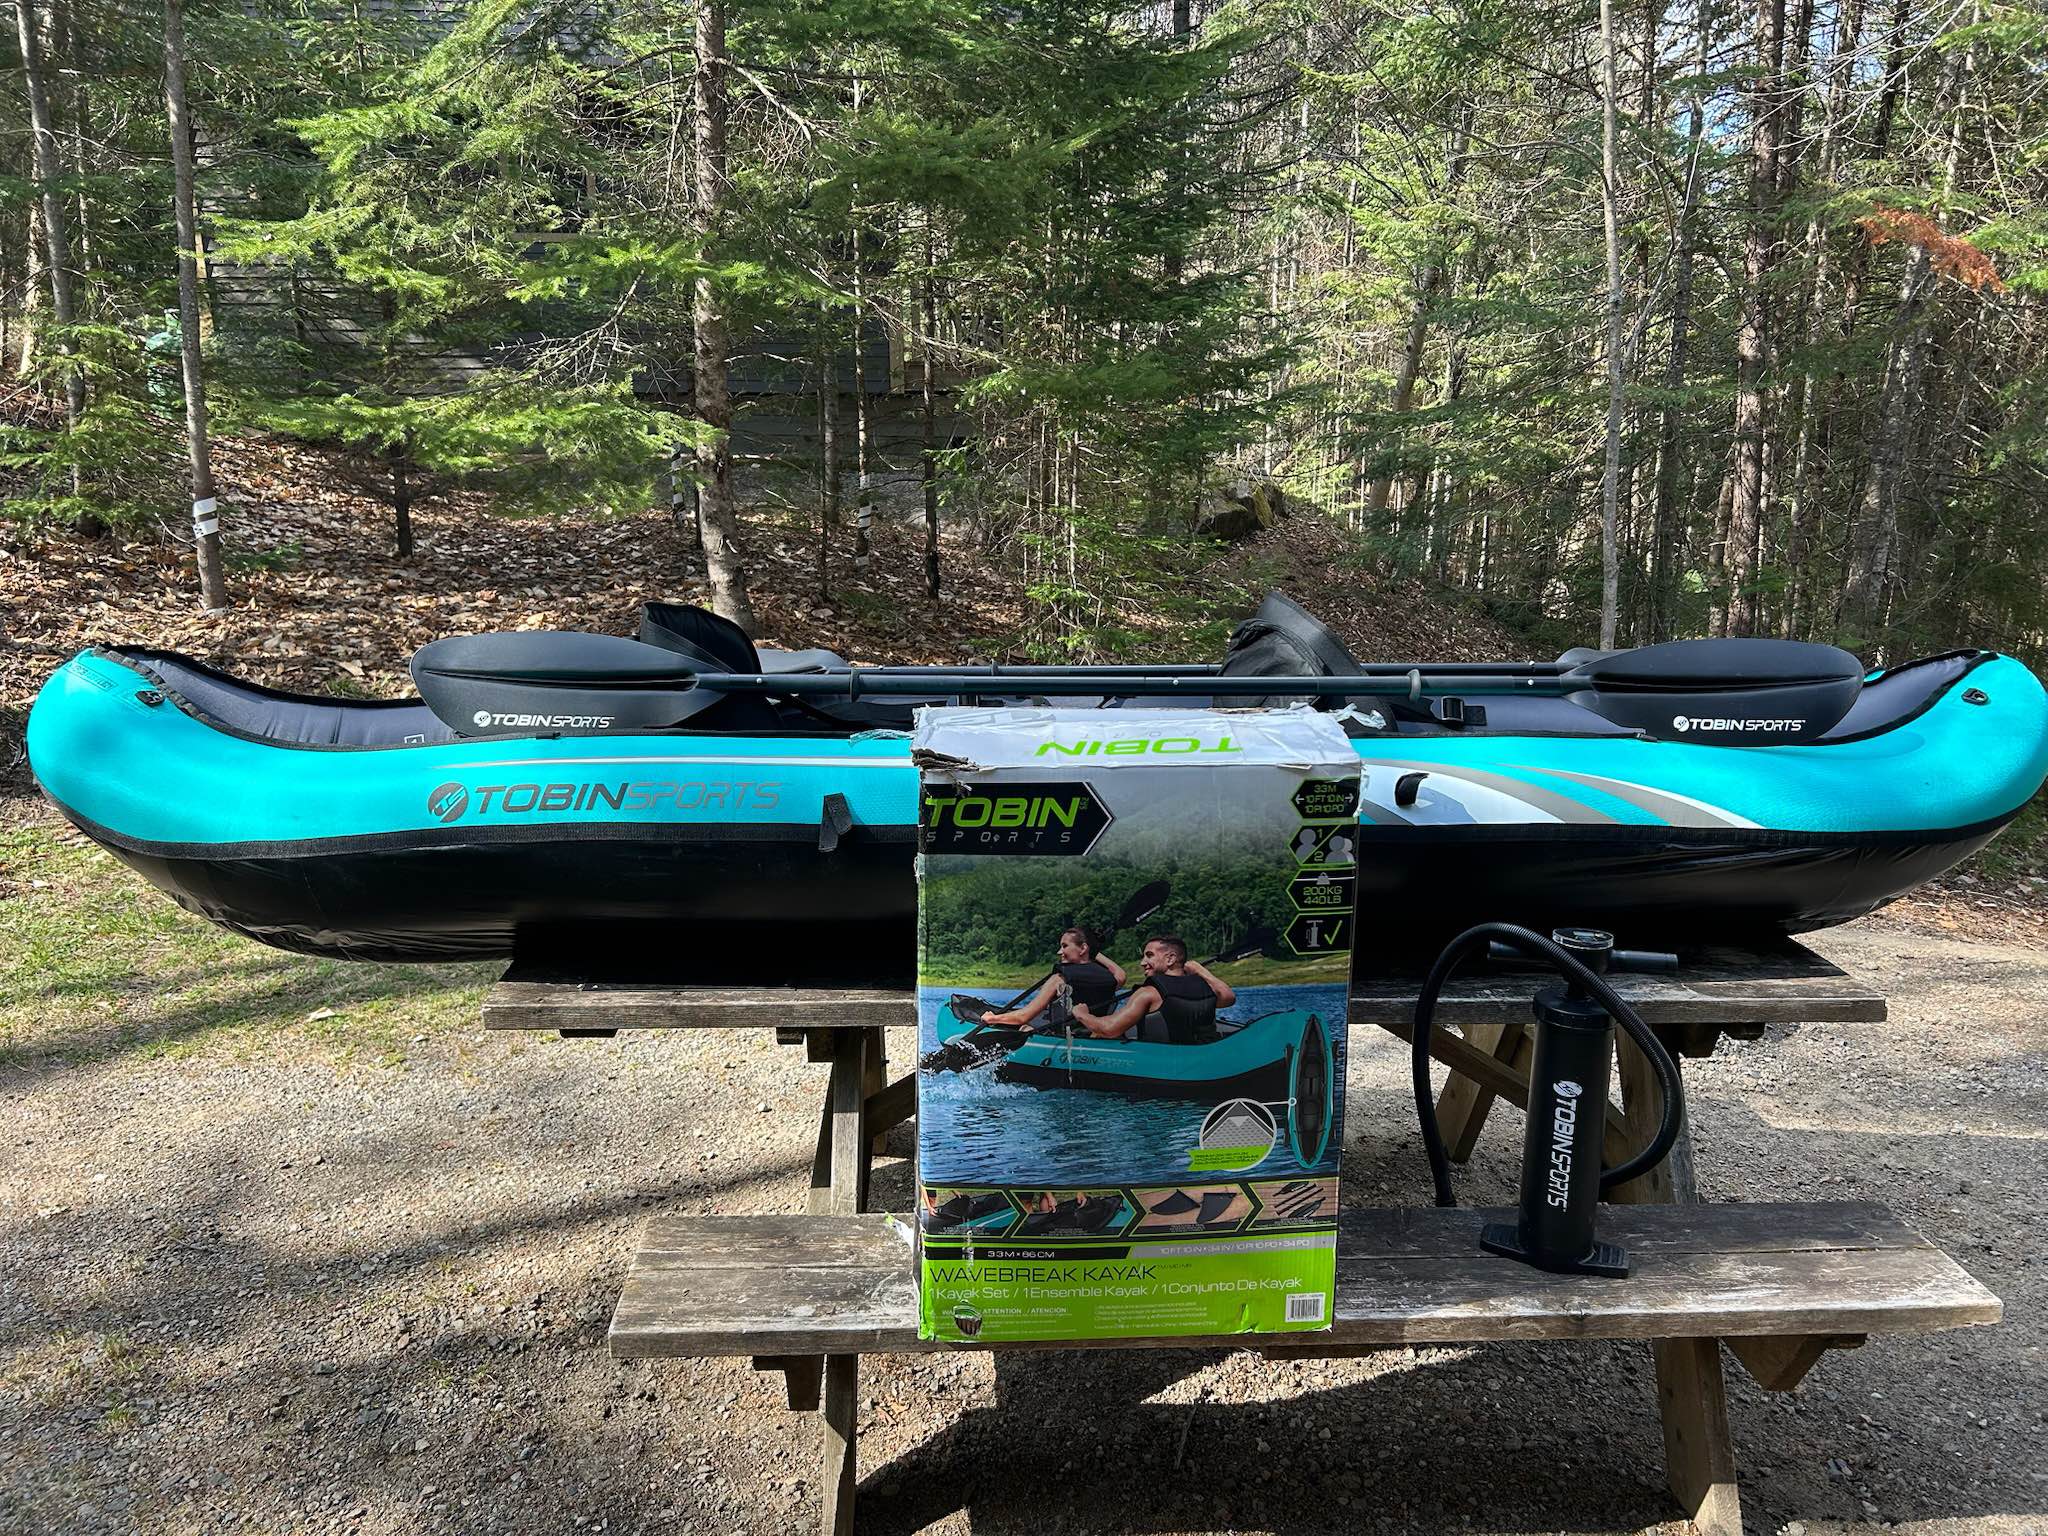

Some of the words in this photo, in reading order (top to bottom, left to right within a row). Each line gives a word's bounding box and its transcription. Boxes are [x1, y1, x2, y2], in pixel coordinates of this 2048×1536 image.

[1034, 737, 1244, 757] TOBIN
[925, 797, 1081, 828] TOBIN
[1316, 829, 1323, 838] 1
[1314, 851, 1324, 861] 2
[929, 1267, 1077, 1283] WAVEBREAK
[1083, 1265, 1157, 1281] KAYAK
[982, 1287, 1010, 1298] Set
[1104, 1285, 1147, 1298] Kayak
[1237, 1280, 1257, 1291] De
[1259, 1277, 1302, 1290] Kayak
